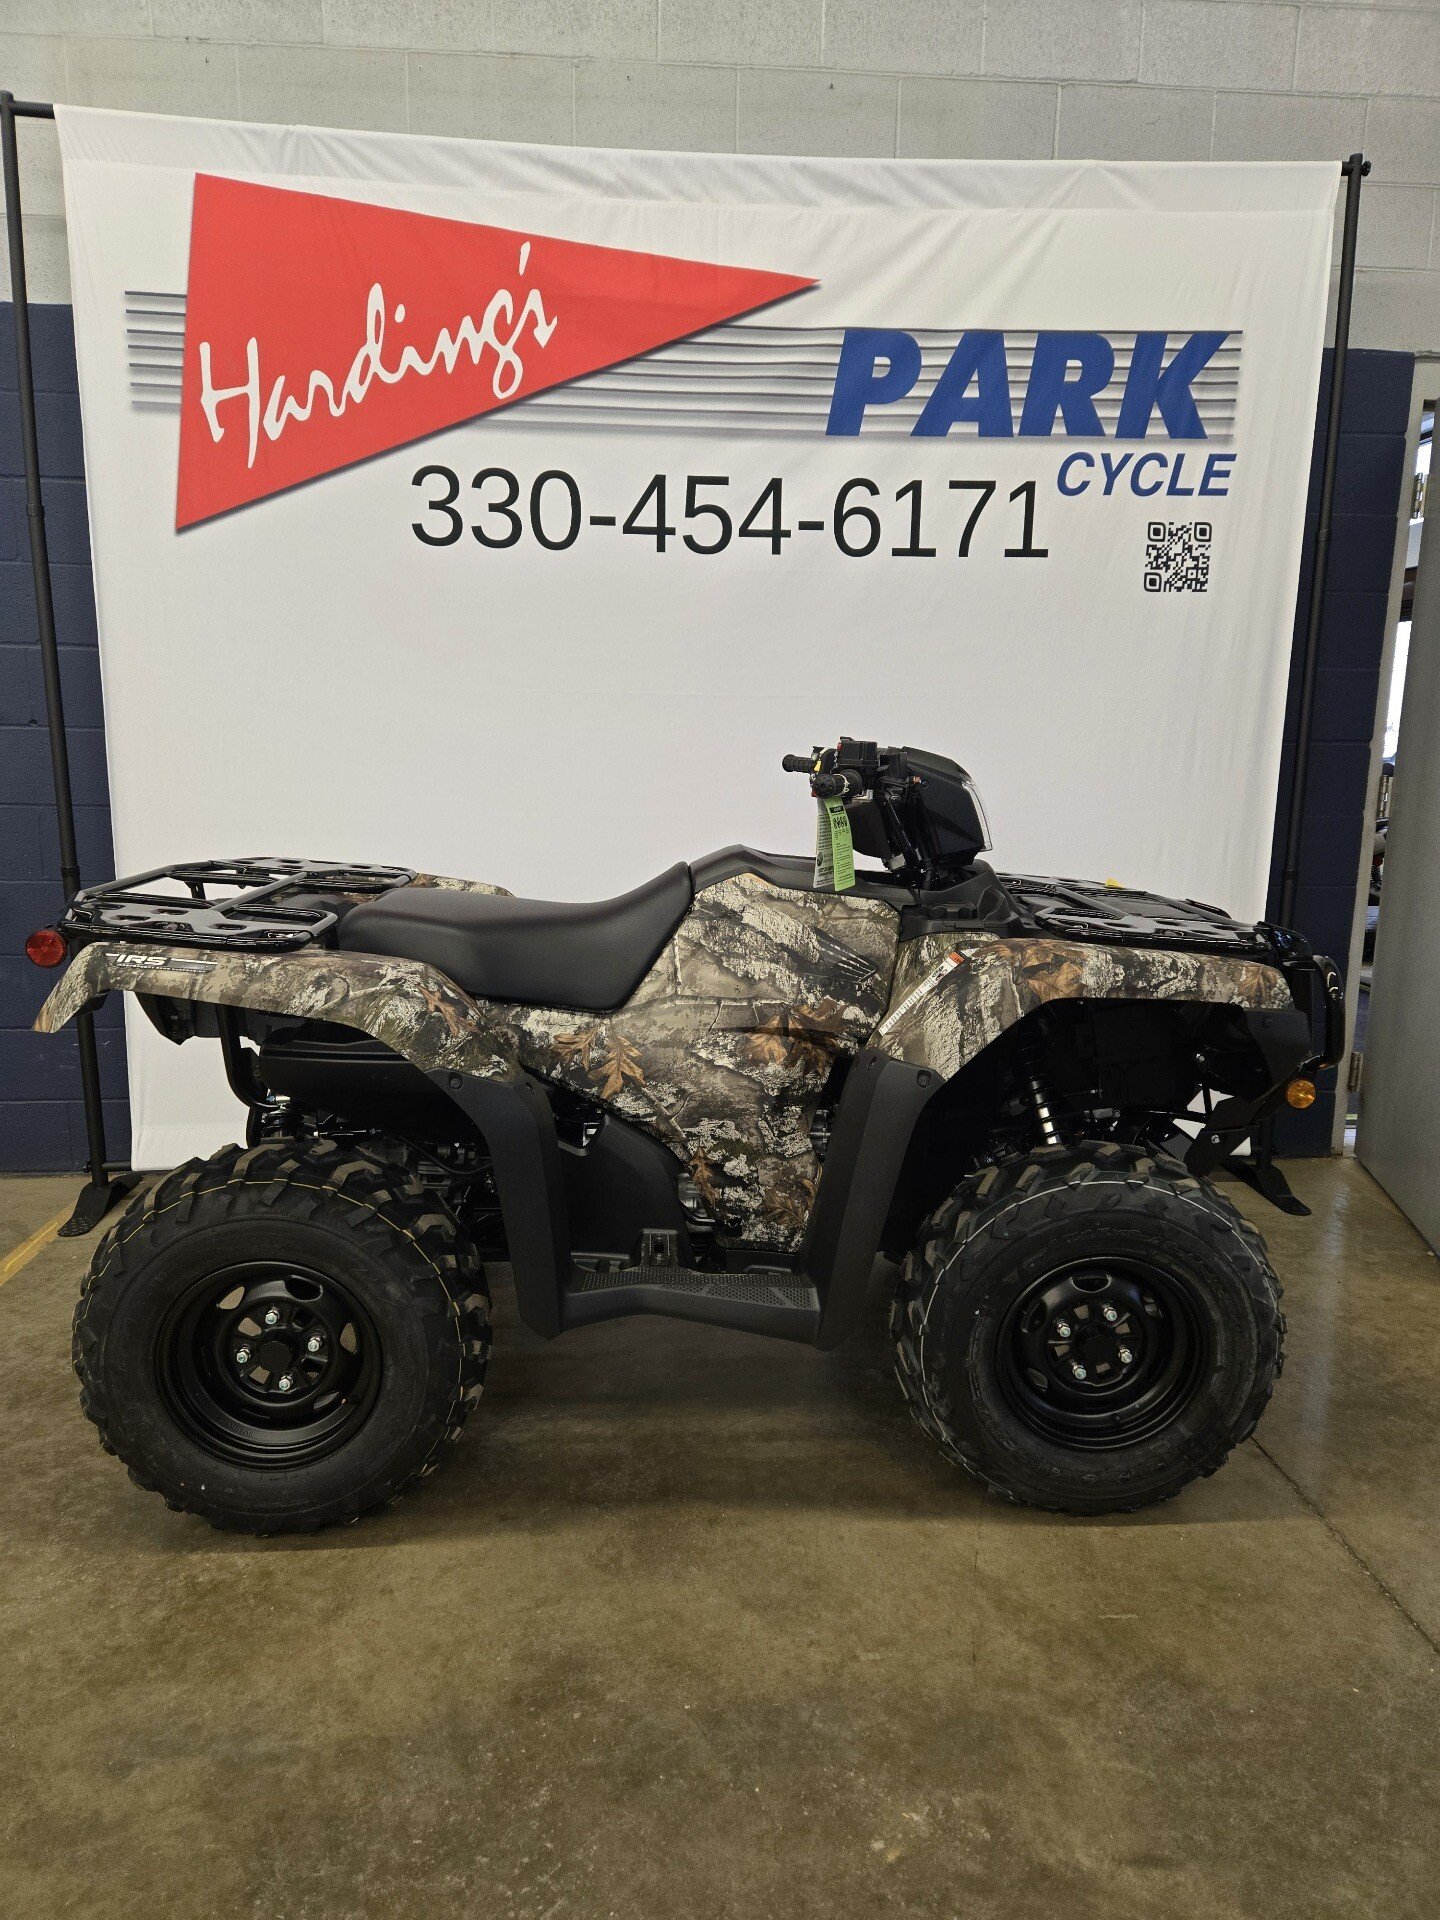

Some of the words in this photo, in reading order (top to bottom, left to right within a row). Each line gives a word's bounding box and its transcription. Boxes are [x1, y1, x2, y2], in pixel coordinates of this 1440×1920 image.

[199, 240, 558, 469] Harding's
[826, 329, 1229, 439] PARK
[411, 465, 1049, 558] 330-454-6171
[1057, 452, 1237, 496] CYCLE
[116, 953, 168, 966] IRS
